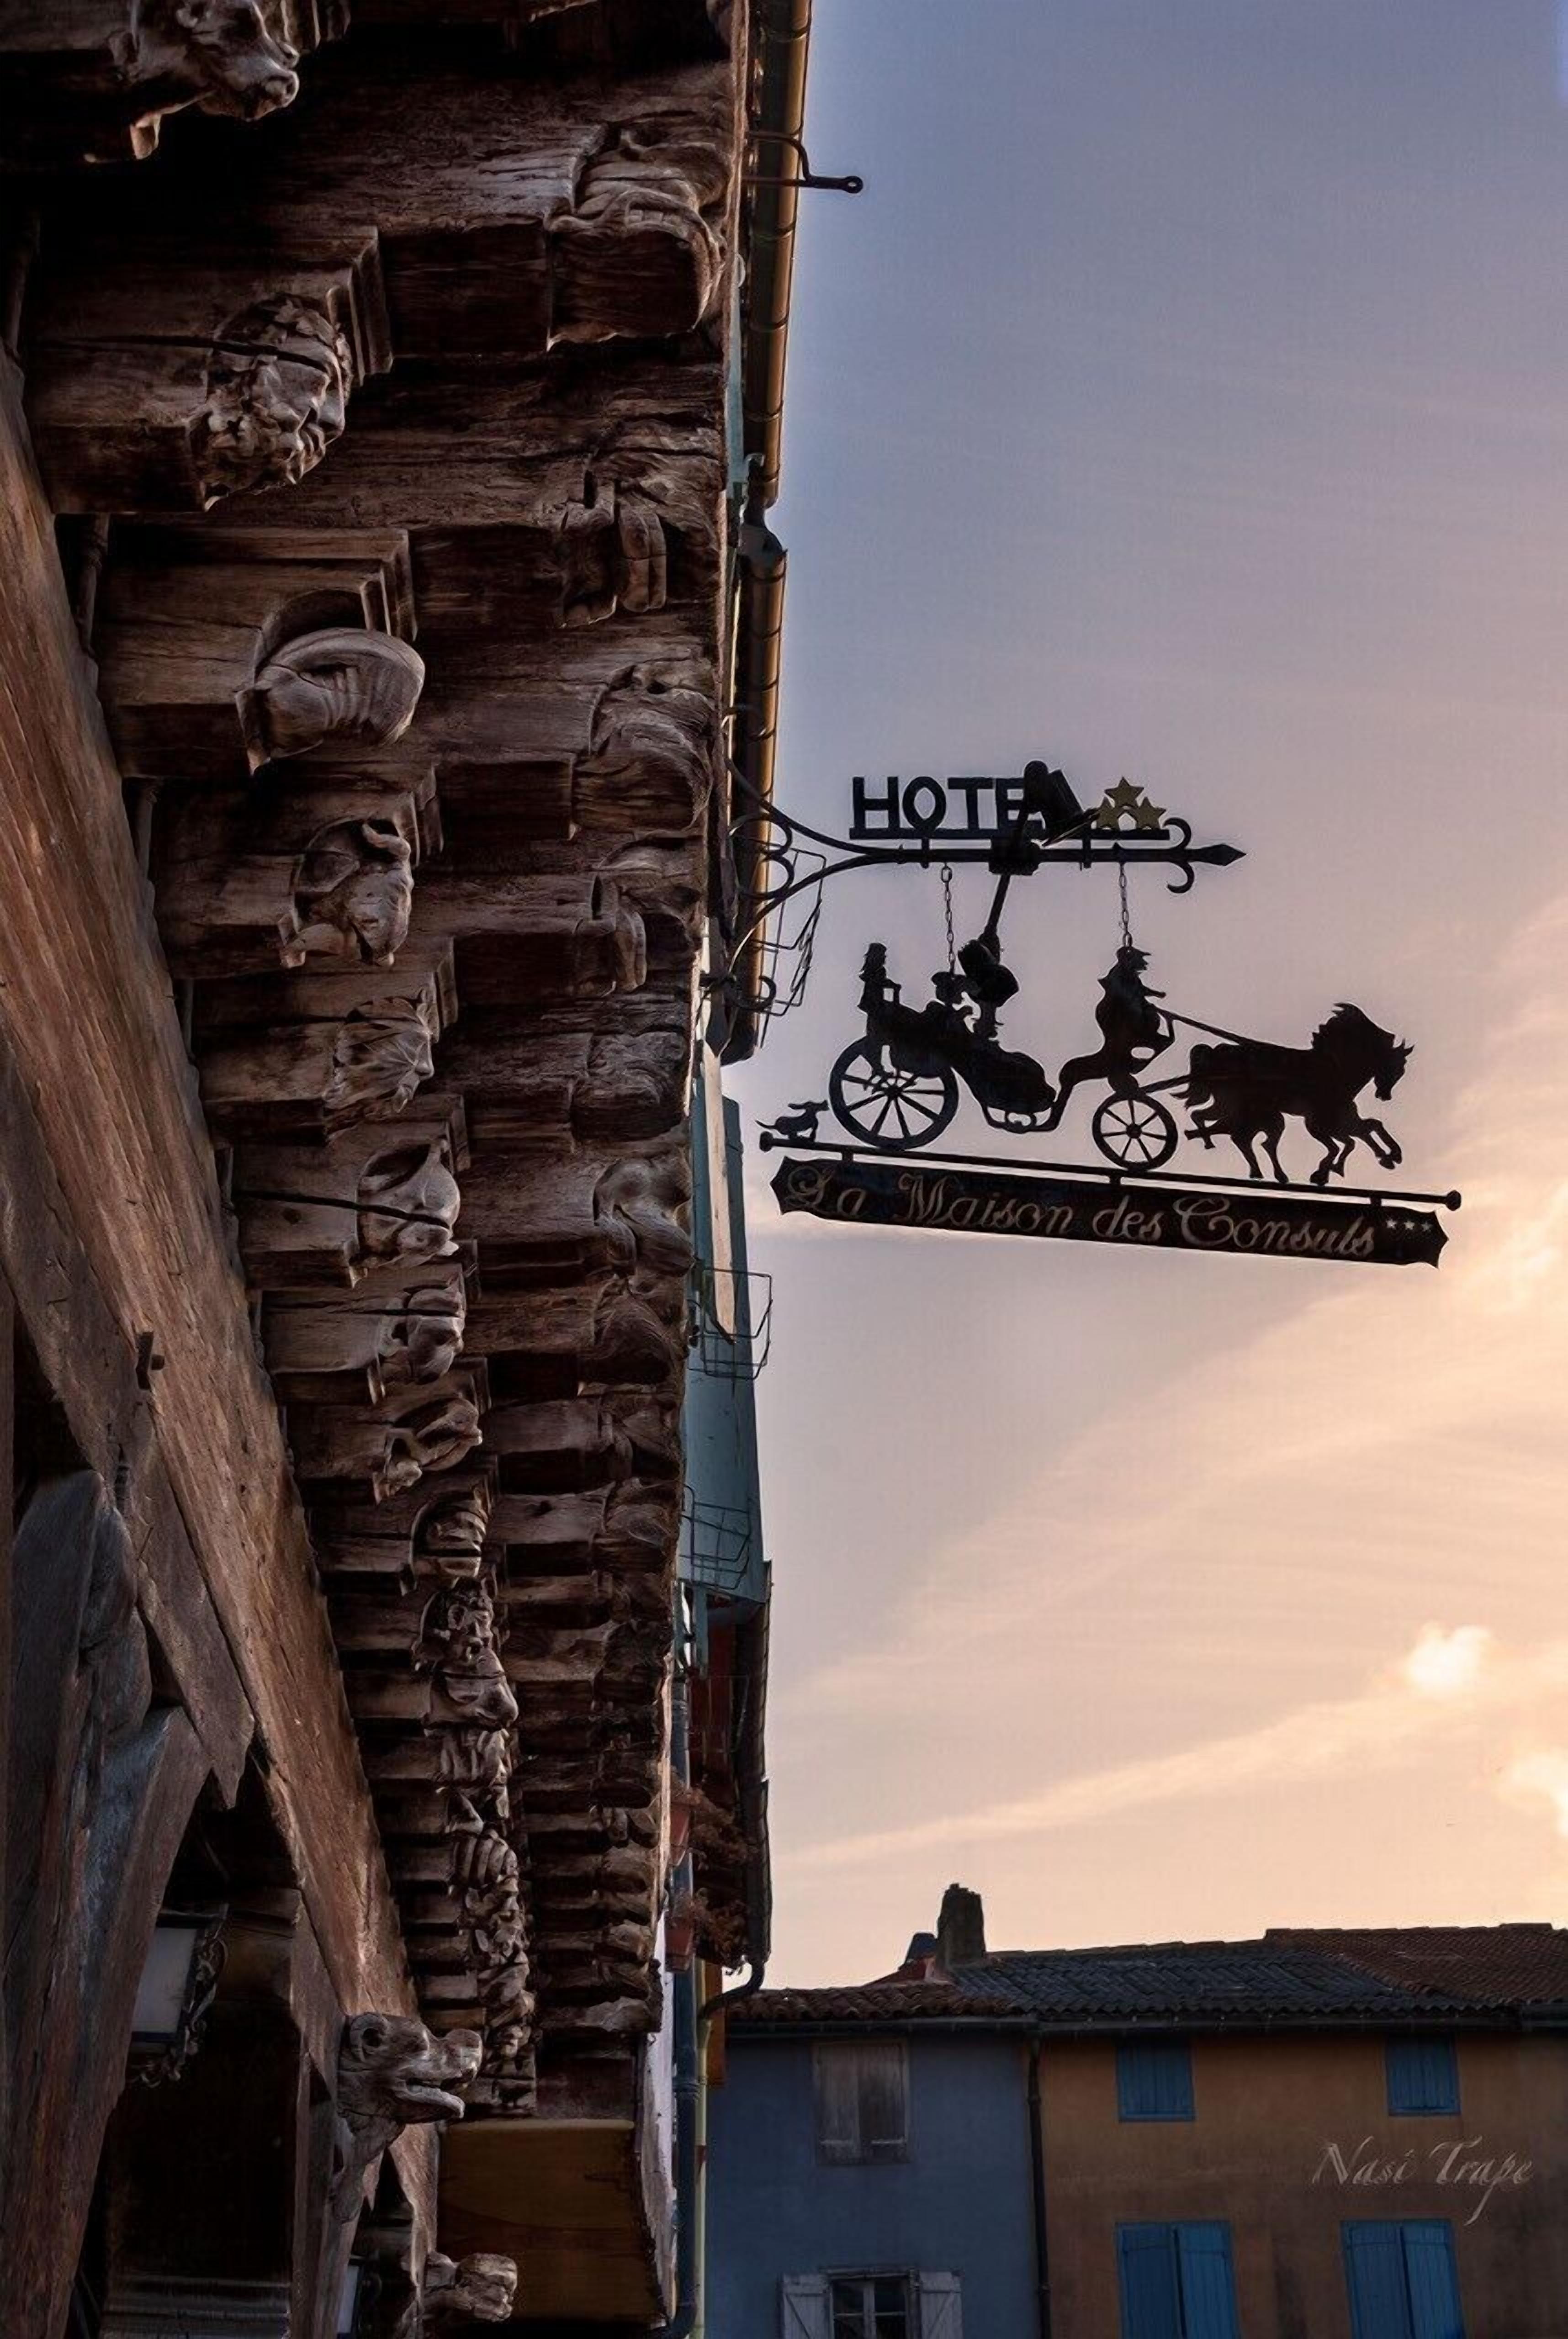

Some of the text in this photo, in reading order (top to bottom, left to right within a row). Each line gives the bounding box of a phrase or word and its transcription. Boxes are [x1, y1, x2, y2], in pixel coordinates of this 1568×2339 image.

[853, 777, 1046, 831] HOTE
[785, 1166, 1375, 1255] La Maison des Consuls
